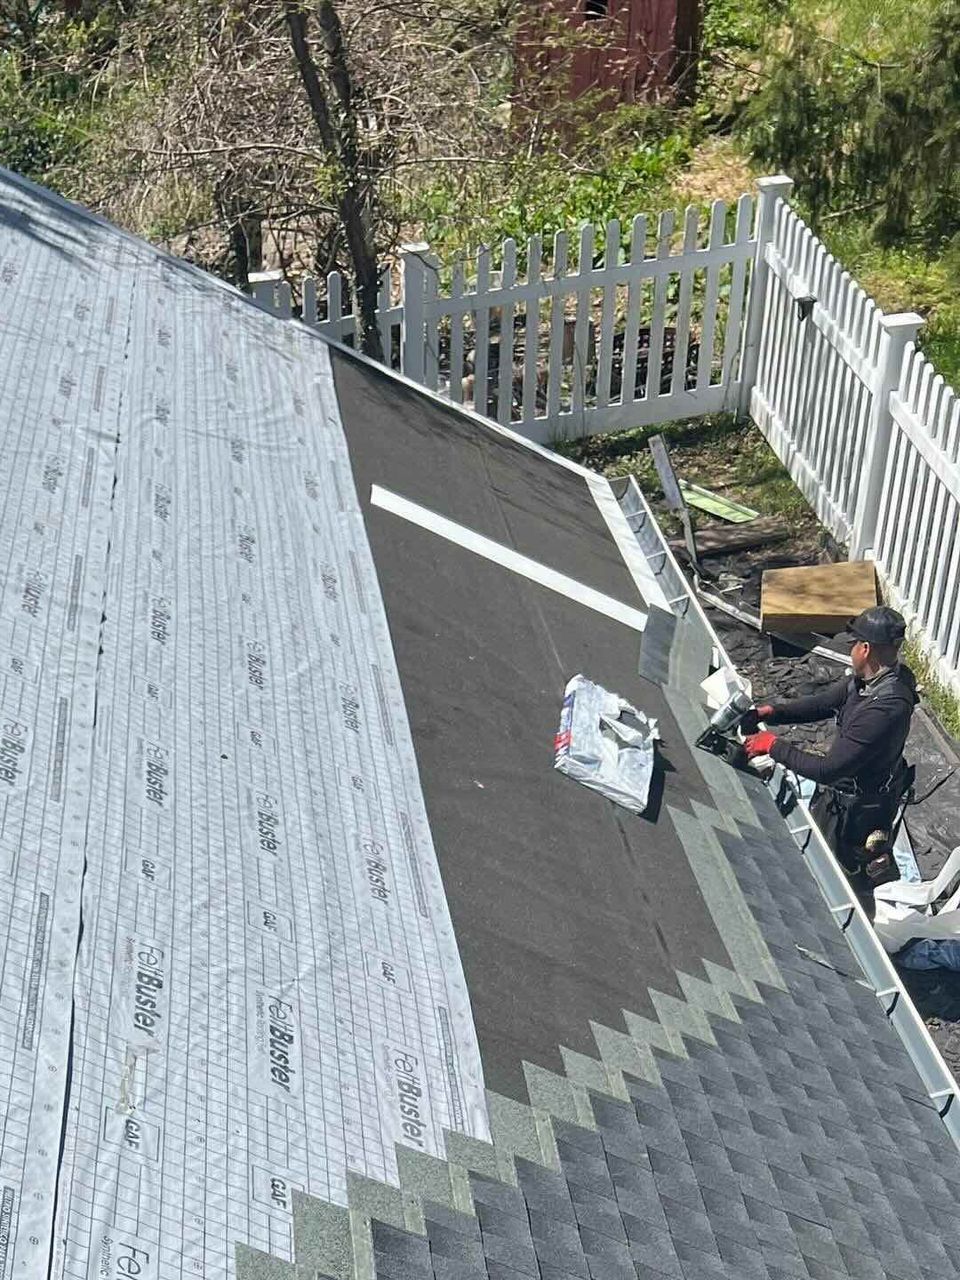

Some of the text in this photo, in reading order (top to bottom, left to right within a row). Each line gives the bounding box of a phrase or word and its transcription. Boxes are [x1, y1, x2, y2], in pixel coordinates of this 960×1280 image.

[146, 740, 169, 807] FeltBuster
[256, 792, 282, 856] FeltBuster
[141, 859, 156, 881] GAF
[360, 839, 390, 906] FeltBuster
[263, 911, 277, 932] GAF
[134, 941, 165, 1038] FeltBuster
[381, 961, 396, 984] GAF
[268, 994, 295, 1092] FeltBuster
[393, 1049, 426, 1147] FeltBuster
[124, 1119, 140, 1150] GAF
[270, 1177, 287, 1210] GAF
[100, 1235, 114, 1277] Synthetic
